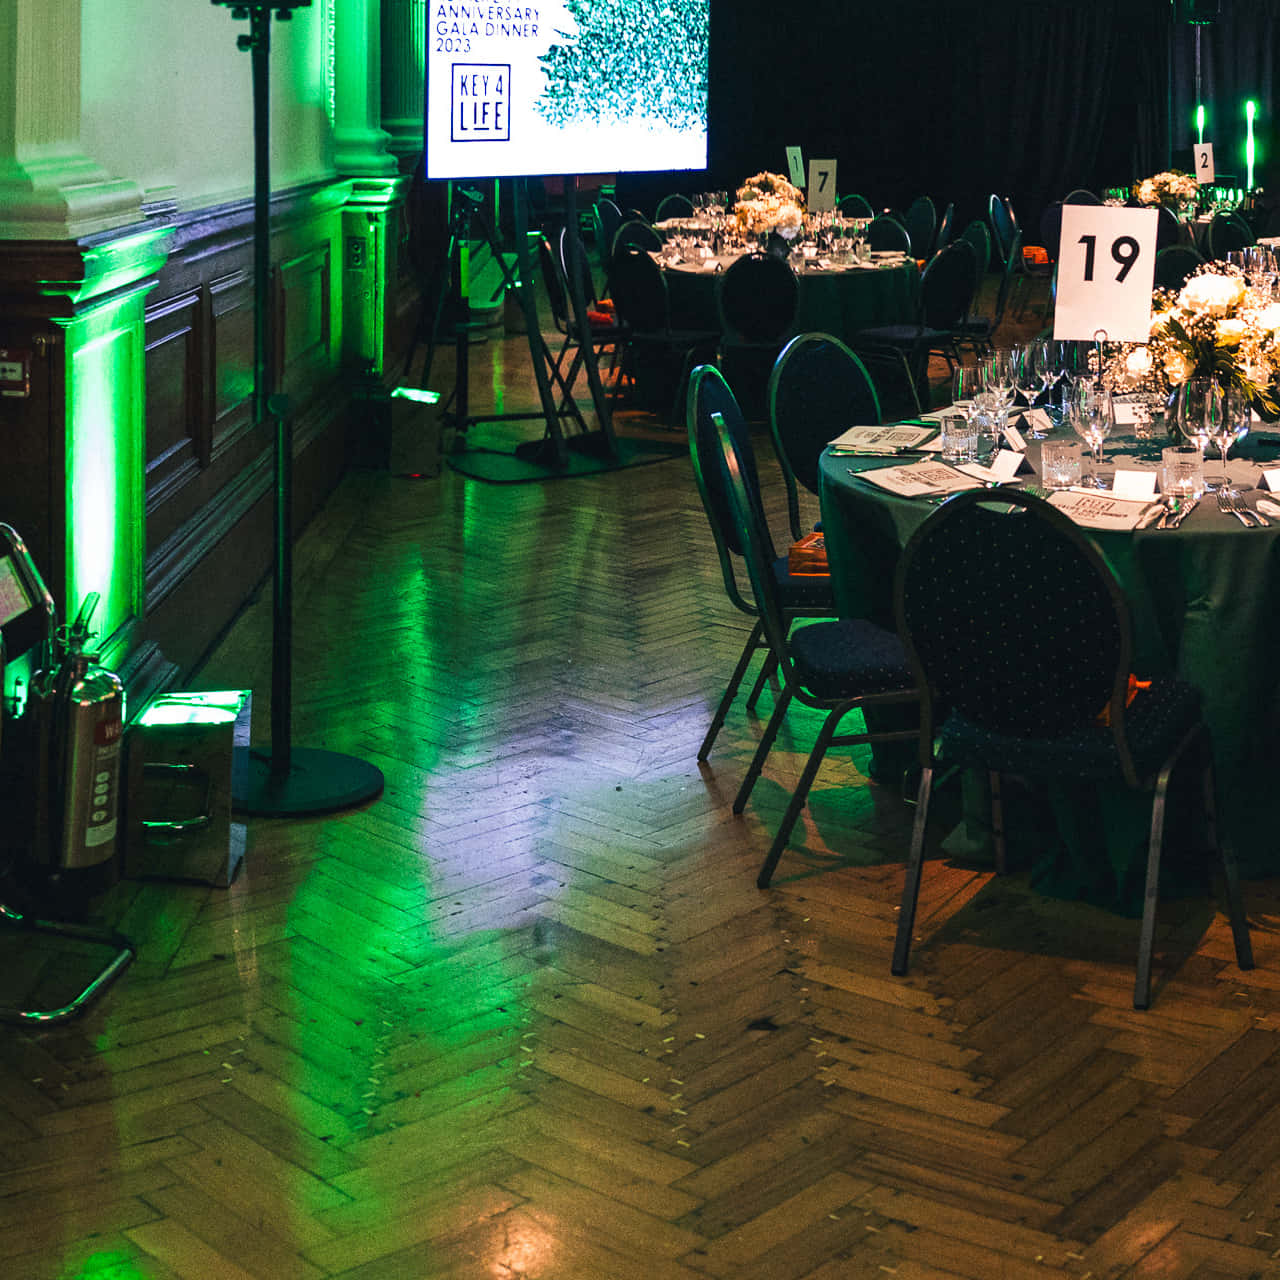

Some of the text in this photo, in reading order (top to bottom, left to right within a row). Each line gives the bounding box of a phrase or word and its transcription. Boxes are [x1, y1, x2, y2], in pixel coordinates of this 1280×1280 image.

[436, 4, 540, 21] ANNIVERSARY
[436, 20, 539, 38] GALA DINNER
[436, 37, 472, 53] 2023
[460, 74, 489, 96] KEY
[460, 101, 503, 130] LIFE
[1201, 152, 1208, 168] 2
[818, 171, 829, 192] 7
[1077, 235, 1140, 283] 19
